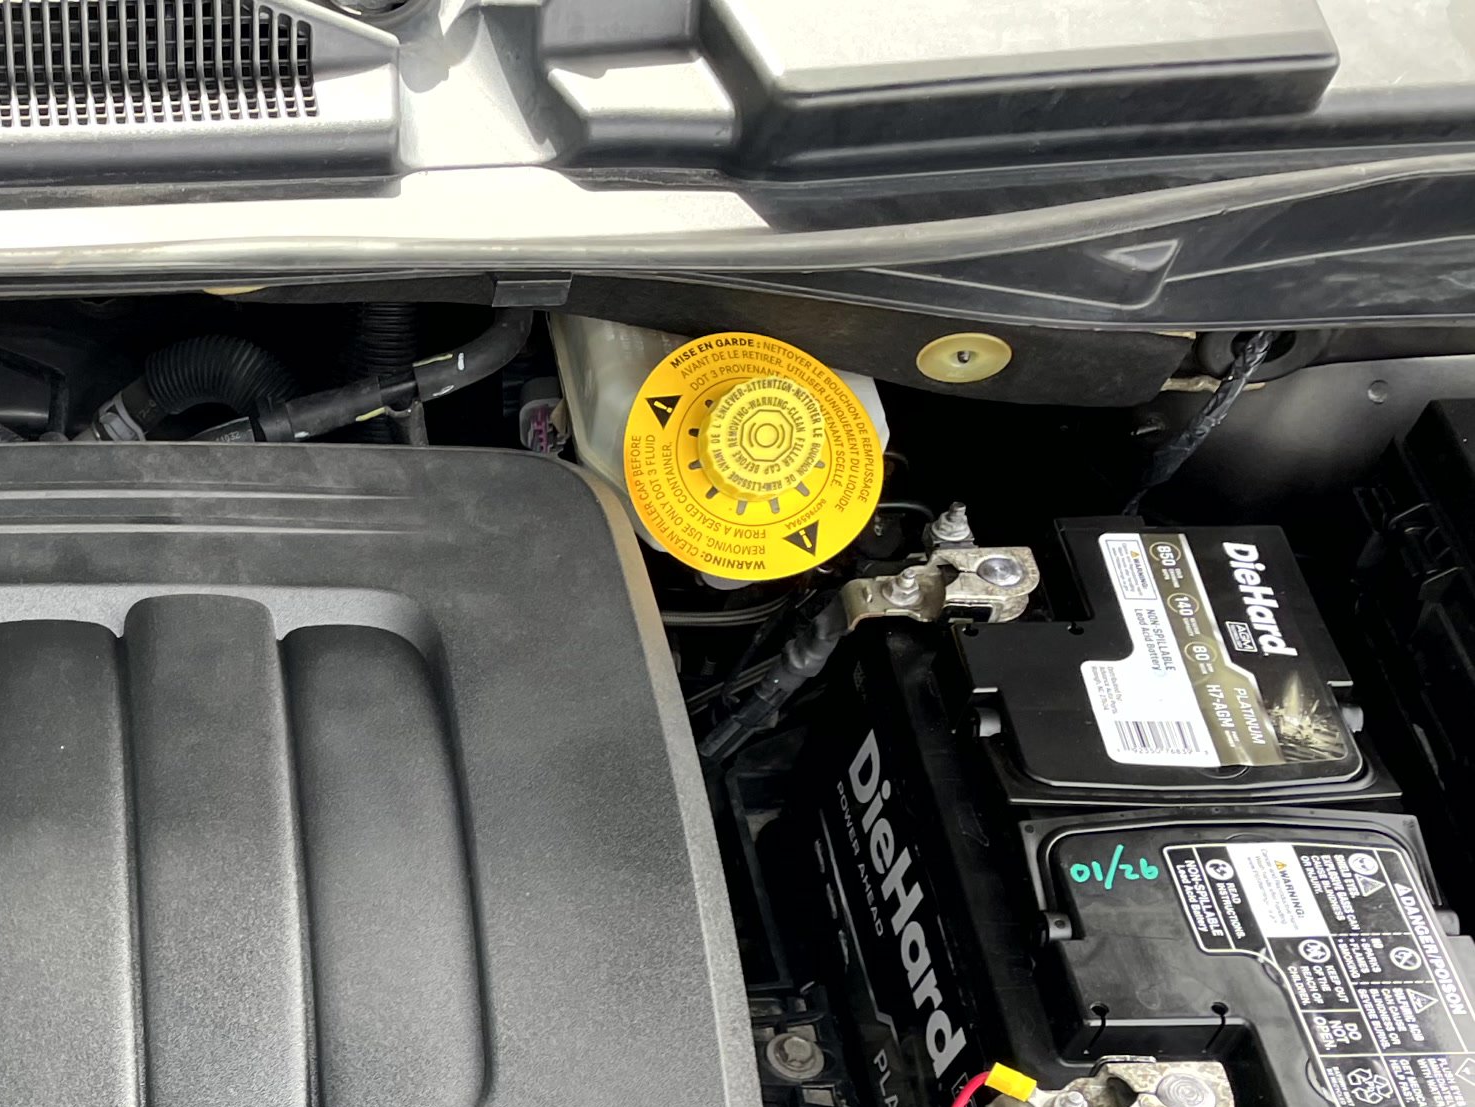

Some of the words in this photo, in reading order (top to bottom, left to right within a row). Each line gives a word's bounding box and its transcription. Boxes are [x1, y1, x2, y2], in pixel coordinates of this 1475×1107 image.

[670, 347, 697, 368] MISE
[698, 342, 713, 353] EN
[712, 352, 724, 362] DE
[728, 350, 740, 359] LE
[763, 342, 812, 370] NETTOYER
[680, 356, 710, 379] AVANT
[690, 373, 710, 391] DOT
[719, 364, 780, 377] PROVENANT
[786, 363, 826, 396] UTILISER
[812, 366, 824, 379] LE
[824, 377, 861, 421] BOUCHON
[824, 394, 860, 455] UNIQUEMENT
[856, 422, 868, 434] DE
[630, 436, 644, 477] BEFORE
[646, 434, 656, 466] FLUID
[732, 450, 760, 474] BEFORE
[782, 438, 806, 468] FILLER
[796, 442, 821, 476] BOUCHON
[662, 442, 688, 504] CONTAINER.
[850, 458, 860, 472] DU
[858, 437, 875, 503] REMPLISSAGE
[634, 480, 650, 500] CAP
[650, 479, 665, 500] DOT
[834, 474, 856, 512] LIQUIDE
[644, 501, 670, 534] FILLER
[660, 501, 683, 526] ONLY
[685, 504, 721, 532] SEALED
[667, 530, 698, 556] CLEAN
[683, 524, 702, 542] USE
[724, 526, 732, 535] A
[734, 528, 766, 539] FROM
[700, 551, 766, 570] WARNING:
[1156, 544, 1177, 567] 850
[1174, 596, 1194, 617] 140
[1223, 542, 1298, 657] DieHard
[1134, 608, 1148, 626] Lead
[1146, 643, 1162, 671] Battery
[1146, 608, 1176, 671] NON-SPILLABLE
[1235, 623, 1256, 650] AGM
[1192, 644, 1210, 662] 80
[1206, 684, 1234, 728] H7-AGM
[1234, 687, 1266, 745] PLATINUM
[836, 780, 860, 856] POWER
[857, 862, 884, 937] AHEAD
[1176, 864, 1192, 884] Lead
[1184, 884, 1198, 902] Acid
[1184, 860, 1224, 936] NON-SPILLABLE
[1226, 882, 1242, 904] READ
[1279, 870, 1304, 918] WARNING:
[1310, 855, 1327, 880] CAUSE
[1322, 880, 1346, 922] BLINDNESS
[1321, 854, 1344, 892] EXPLOSIVE
[1346, 914, 1360, 931] CAN
[849, 728, 967, 1080] DieHard
[1190, 904, 1208, 932] Battery
[1216, 882, 1246, 940] INSTRUCTIONS.
[1400, 896, 1467, 1016] DANGER/POISON
[1288, 966, 1311, 1006] CHILDREN.
[1300, 966, 1318, 992] REACH
[1318, 976, 1332, 992] THE
[1325, 964, 1342, 986] KEEP
[1334, 986, 1350, 1004] OUT
[1357, 988, 1378, 1020] SEVERE
[1369, 988, 1395, 1032] BLINDNESS
[1381, 988, 1395, 1005] CAN
[1389, 1006, 1408, 1032] CAUSE
[1392, 988, 1416, 1022] SULFURIC
[1408, 1023, 1425, 1042] ACID
[1314, 1016, 1338, 1050] OPEN.
[1328, 1020, 1350, 1044] NOT
[1344, 1023, 1362, 1040] DO
[1388, 1059, 1405, 1080] HELP
[1400, 1058, 1414, 1076] GET
[1417, 1058, 1432, 1078] WITH
[1438, 1058, 1456, 1084] FLUSH
